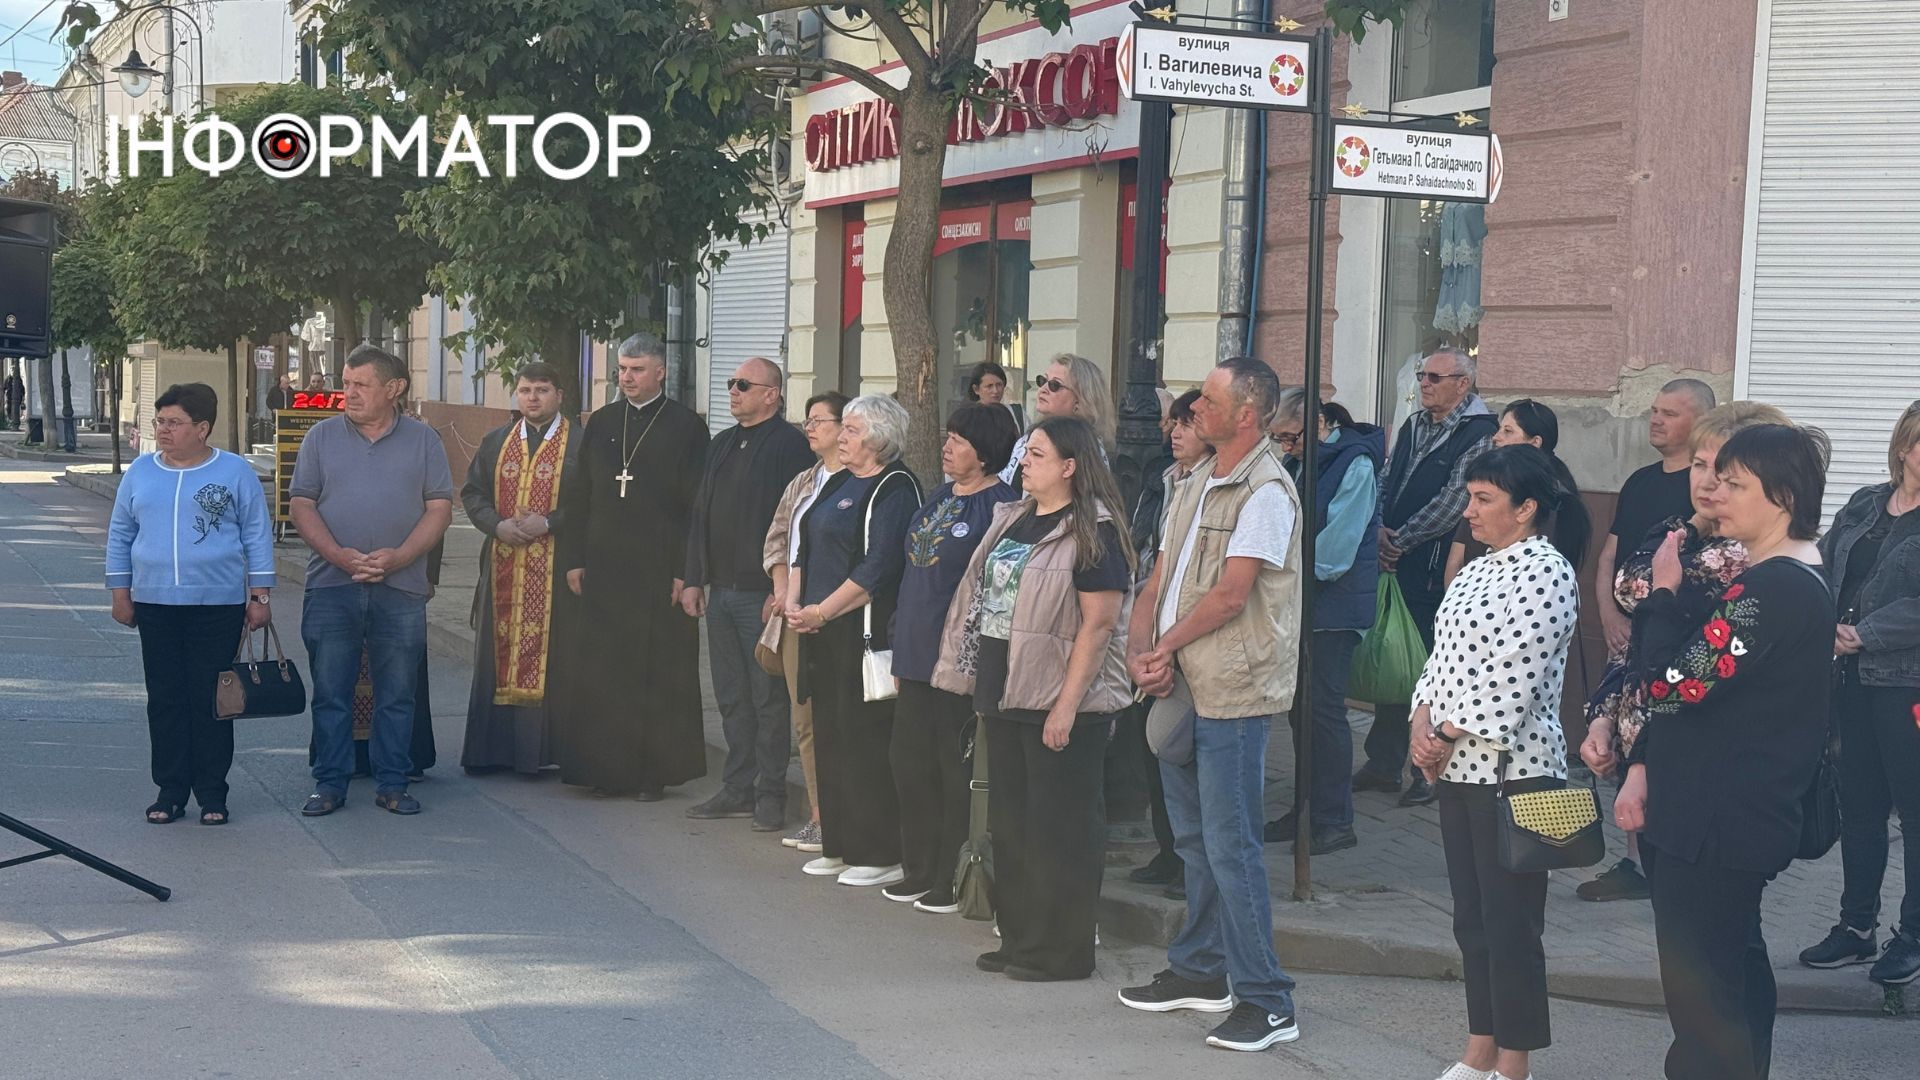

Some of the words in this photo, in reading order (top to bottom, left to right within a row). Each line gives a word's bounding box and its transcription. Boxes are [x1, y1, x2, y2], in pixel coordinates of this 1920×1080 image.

[1178, 37, 1230, 53] вулиця
[1159, 54, 1262, 79] Вагилевича
[1161, 77, 1236, 96] Vahylevycha
[1239, 83, 1255, 97] St.
[804, 98, 901, 172] ОПТИК
[1406, 134, 1452, 148] вулиця
[1372, 147, 1412, 167] Гетьмана
[1414, 151, 1423, 168] П.
[1425, 154, 1483, 173] Сагайдачного
[1378, 171, 1407, 185] Hetmana
[1408, 174, 1414, 186] P.
[1415, 174, 1465, 190] Sahaidachnoho
